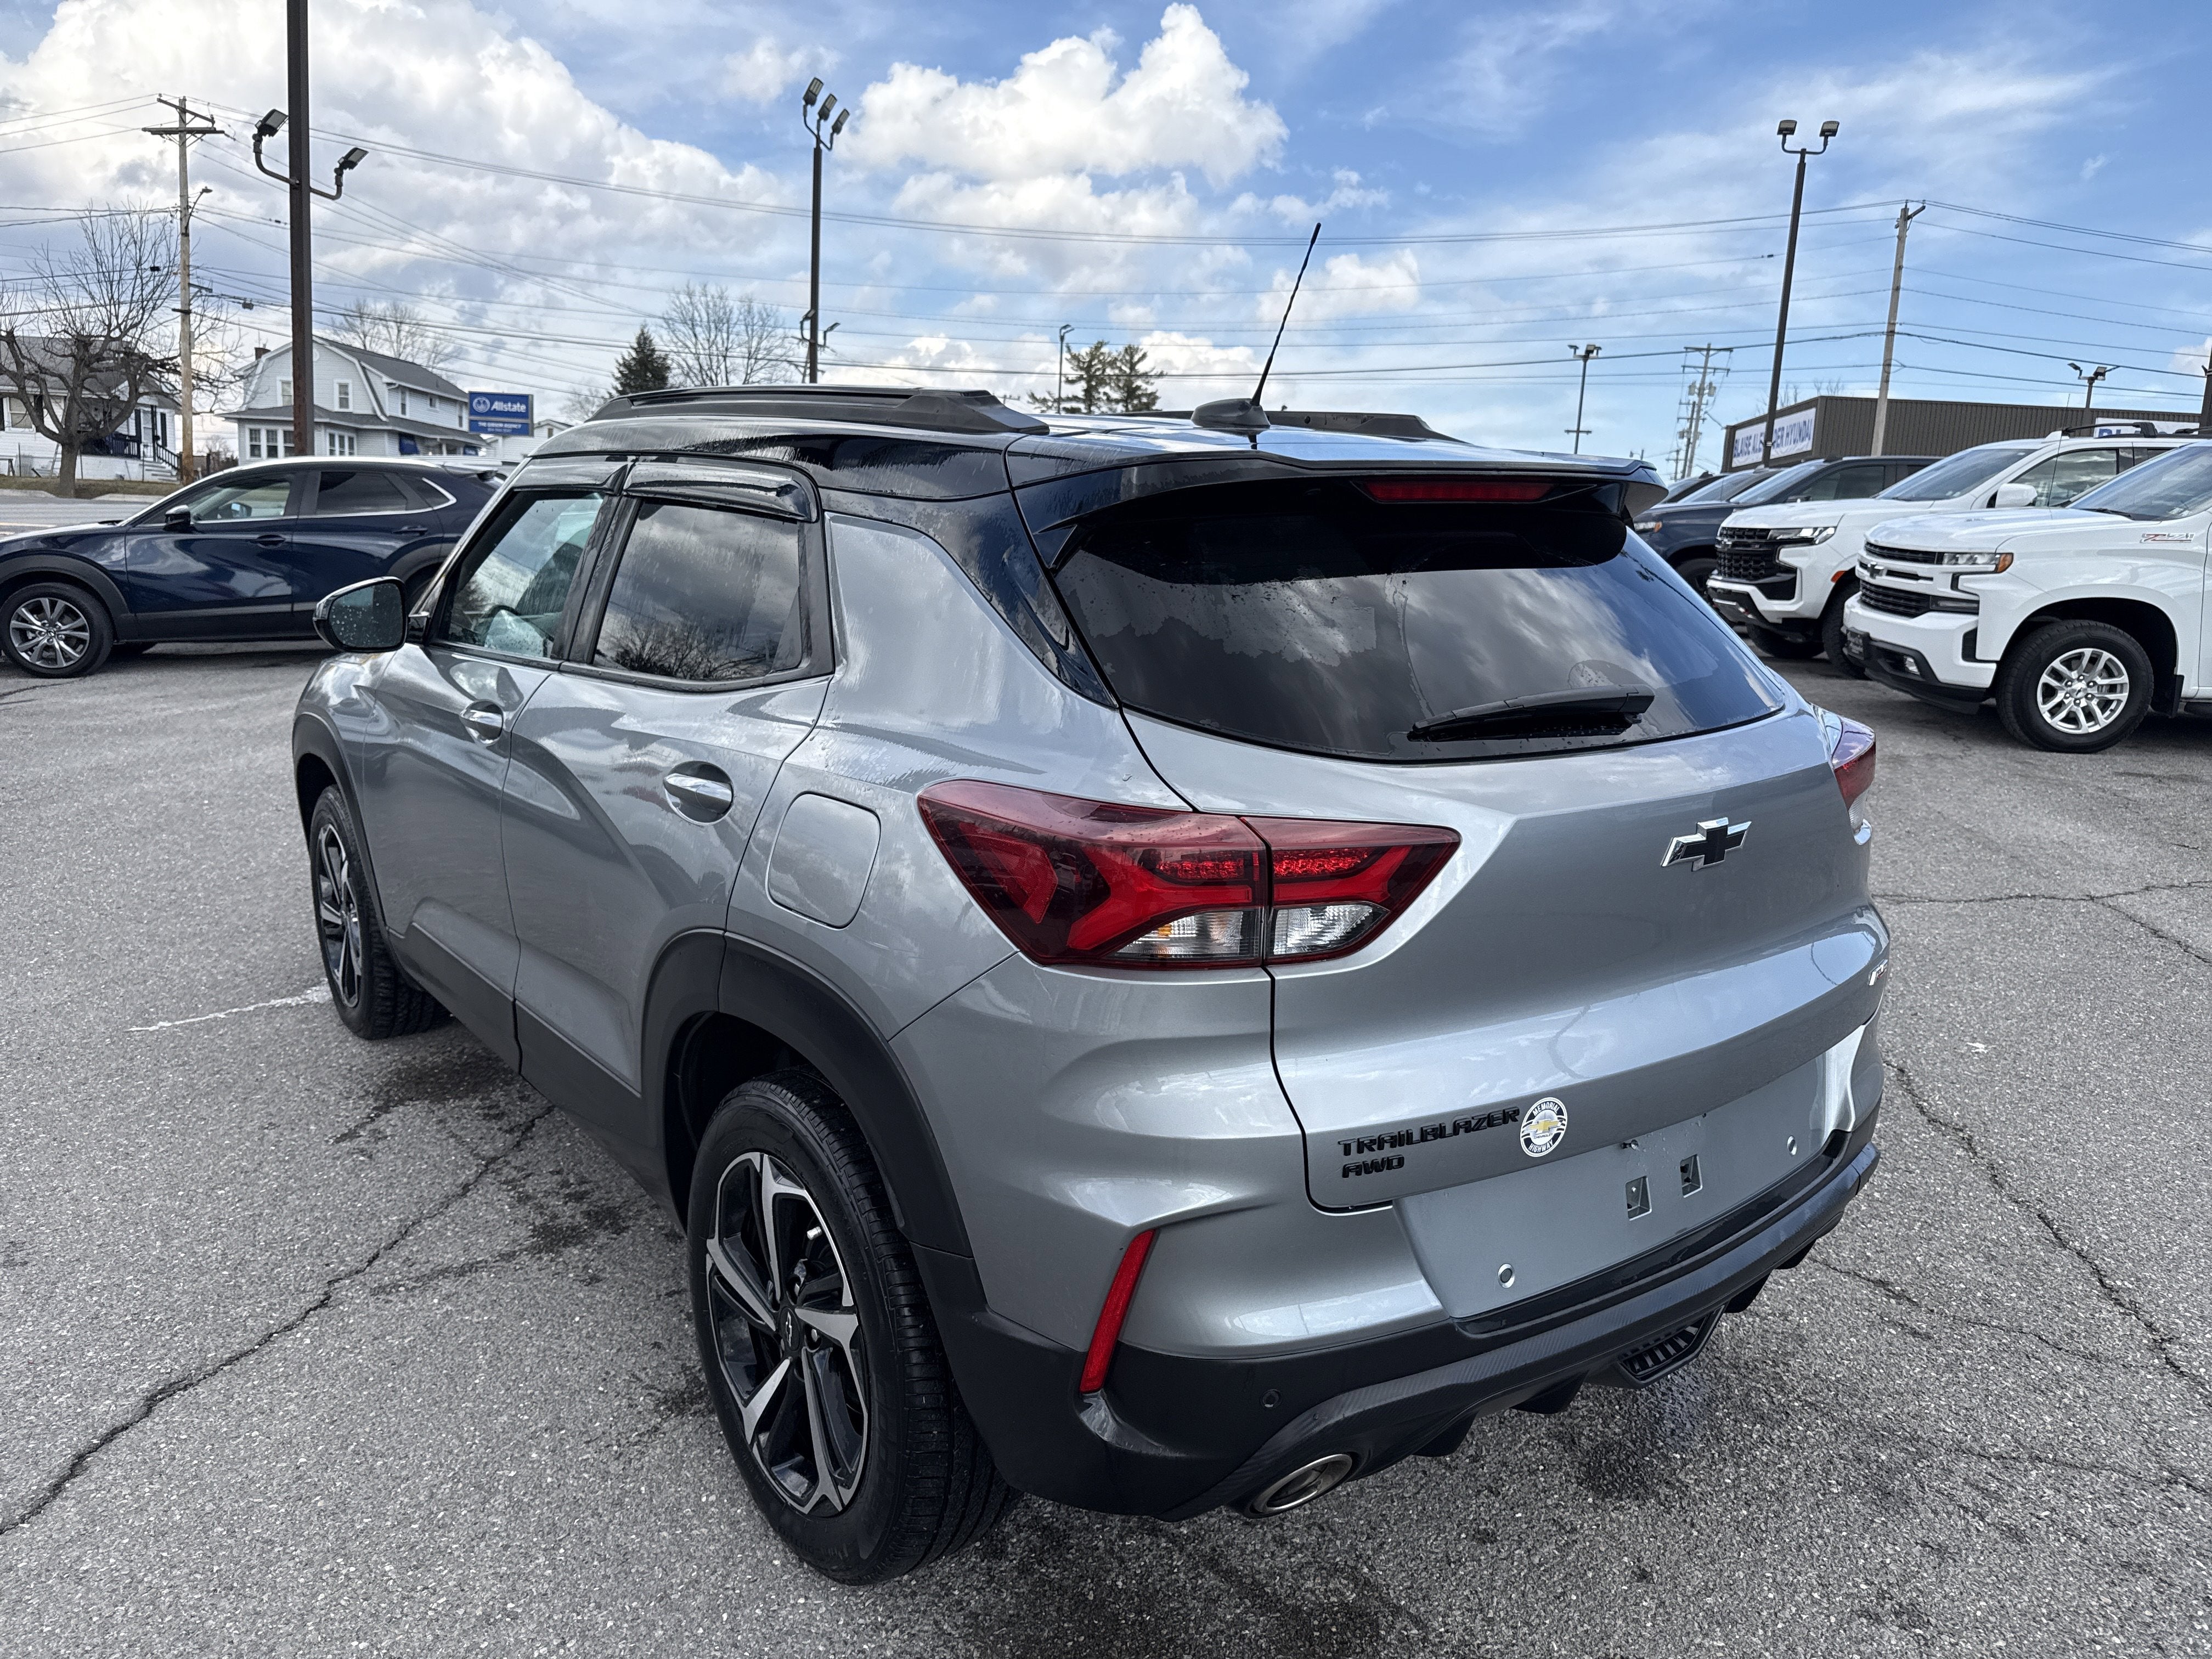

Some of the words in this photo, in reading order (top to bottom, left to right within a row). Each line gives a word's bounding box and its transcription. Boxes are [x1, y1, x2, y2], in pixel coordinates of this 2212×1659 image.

[490, 400, 526, 413] Allstate
[1734, 433, 1752, 458] BLAISE
[1785, 419, 1813, 447] HYUNDAI
[2140, 532, 2194, 544] Z71
[1532, 1102, 1560, 1116] MEMORIAL
[1338, 1106, 1520, 1156] TRAILBLAZER
[1528, 1139, 1554, 1153] HIGHWAY
[1342, 1154, 1405, 1178] AWD
